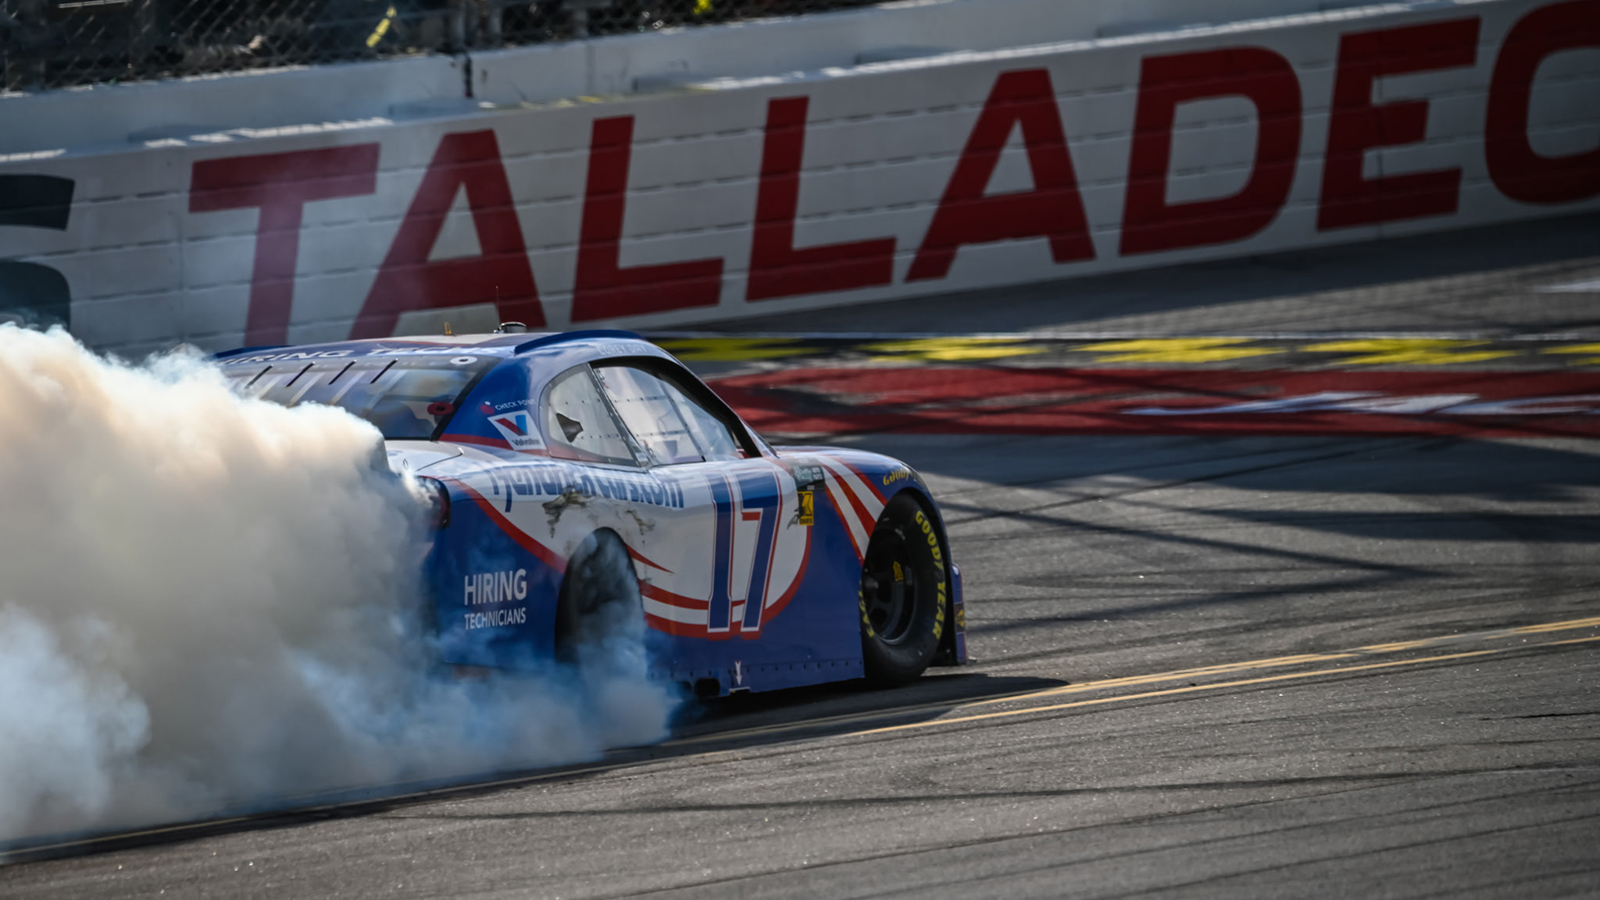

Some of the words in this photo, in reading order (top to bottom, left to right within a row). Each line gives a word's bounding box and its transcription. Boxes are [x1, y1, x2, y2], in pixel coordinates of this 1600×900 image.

[494, 401, 517, 411] CHECK
[701, 468, 783, 634] 17
[464, 568, 527, 606] HIRING
[464, 607, 527, 630] TECHNICIANS
